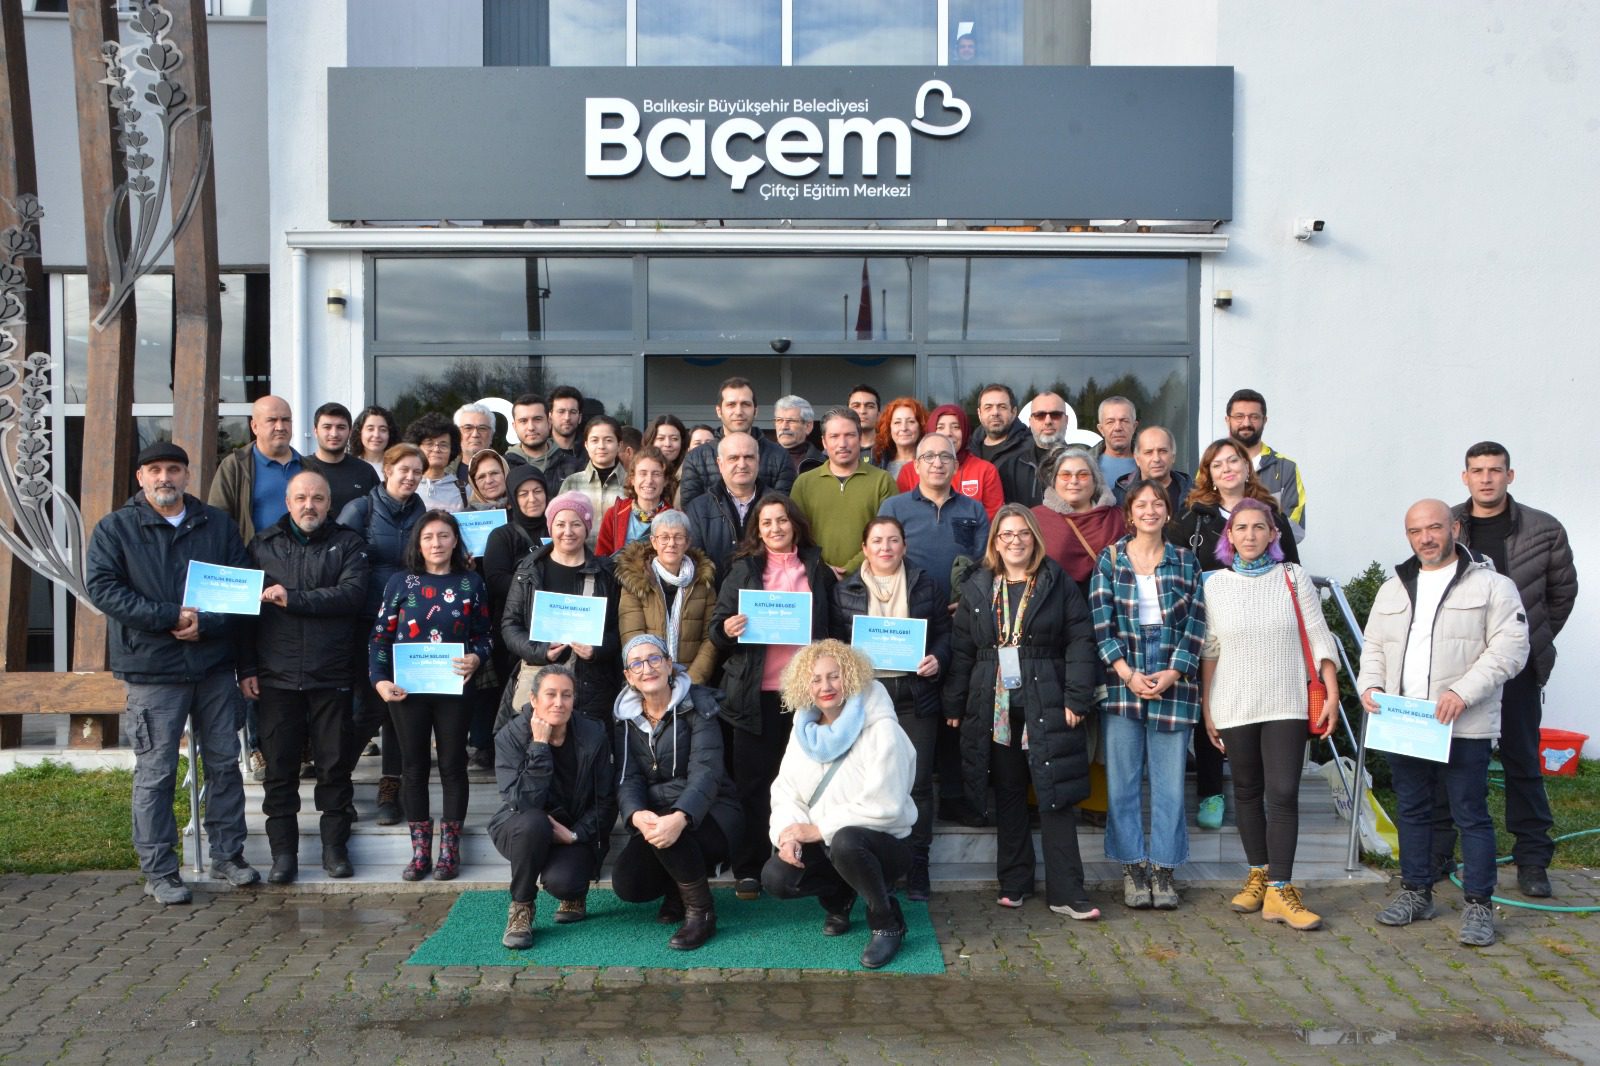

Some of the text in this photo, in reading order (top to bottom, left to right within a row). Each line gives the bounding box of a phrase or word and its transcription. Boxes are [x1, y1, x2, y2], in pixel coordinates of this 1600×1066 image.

[643, 99, 869, 116] Balıkesir Büyükşehir Belediyesi
[585, 96, 912, 190] Baçem
[759, 183, 911, 200] Çiftçi Eğitim Merkezi
